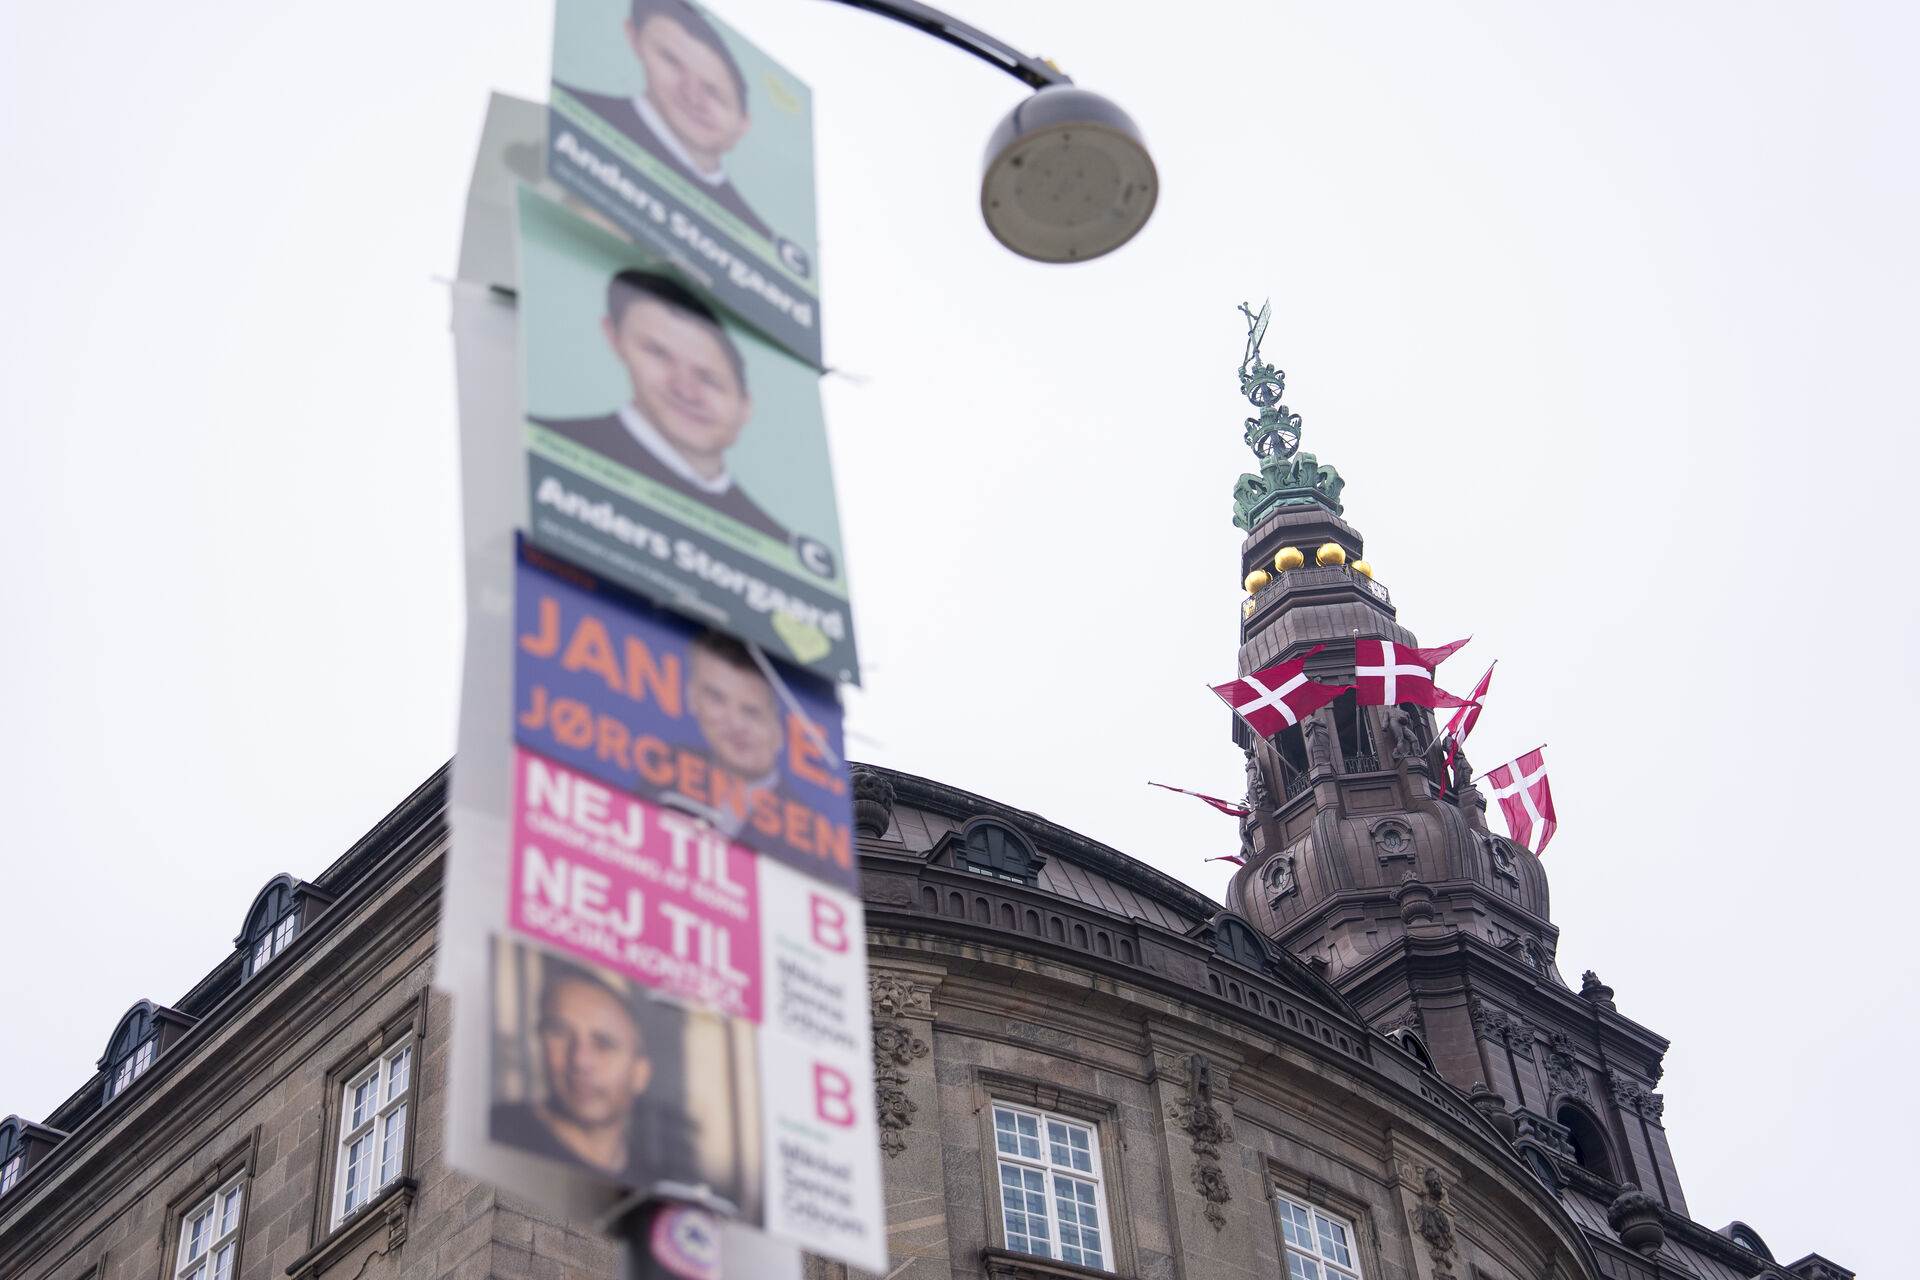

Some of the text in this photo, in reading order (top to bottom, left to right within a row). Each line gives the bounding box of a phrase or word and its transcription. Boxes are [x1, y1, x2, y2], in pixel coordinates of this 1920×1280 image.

[555, 131, 666, 223] Anders
[669, 212, 813, 327] Storgaard
[537, 476, 672, 559] Anders
[673, 540, 846, 641] Storgaard
[801, 541, 830, 576] C
[519, 596, 683, 720] JAN
[519, 685, 854, 869] JØRGENSEN
[526, 756, 748, 899] NEJ TIL
[522, 846, 750, 988] NEJ TIL
[808, 892, 851, 955] B
[812, 1060, 858, 1128] B
